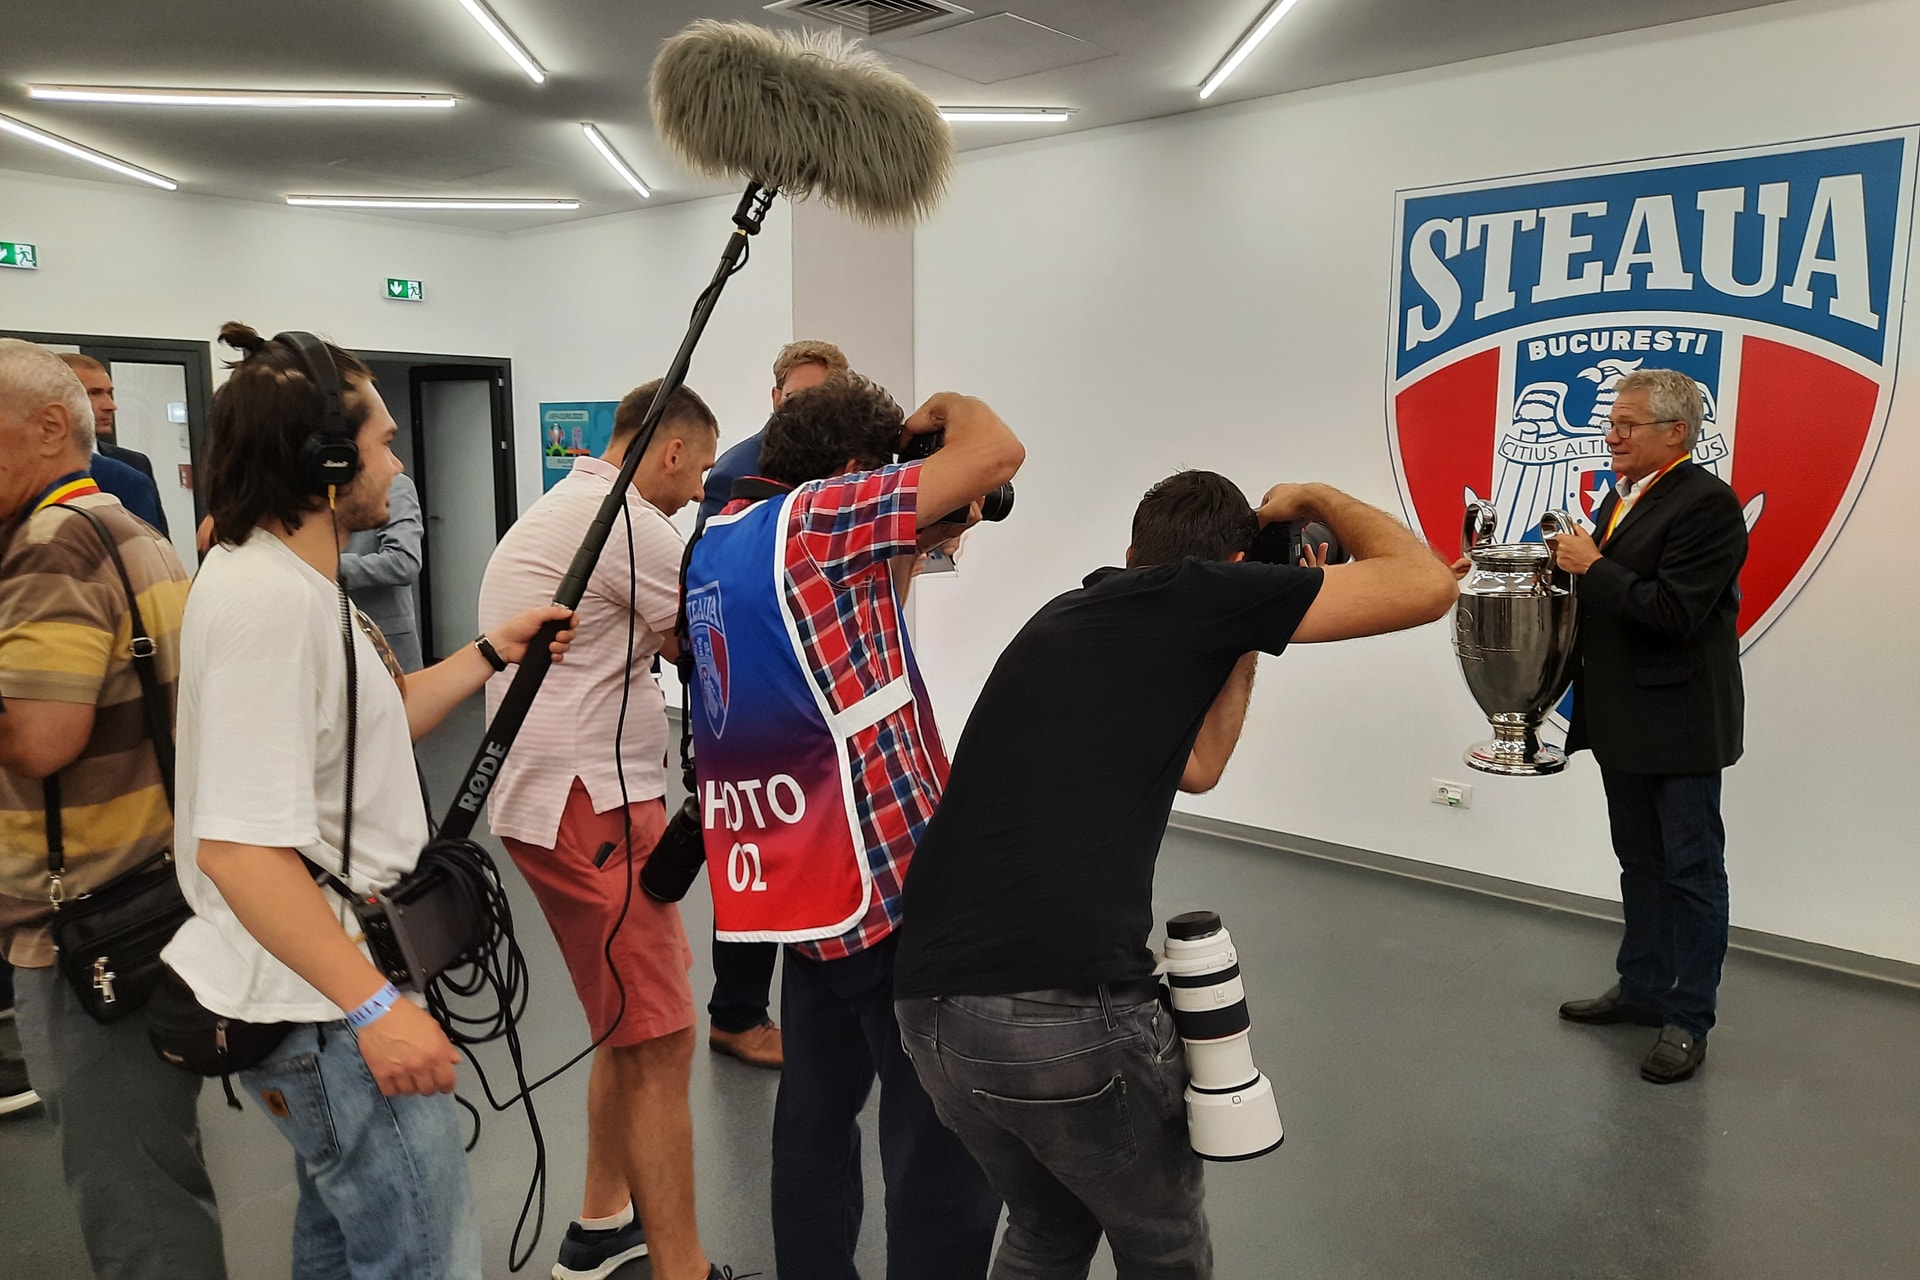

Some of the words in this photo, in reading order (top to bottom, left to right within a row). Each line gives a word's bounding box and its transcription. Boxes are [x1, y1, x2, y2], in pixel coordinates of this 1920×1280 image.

[1405, 173, 1879, 351] STEAUA
[1527, 329, 1708, 362] BUCURESTI
[1502, 441, 1558, 461] CITIUS
[1564, 439, 1612, 456] ALTI
[686, 594, 721, 630] TEAUA
[458, 741, 507, 813] RØDE
[697, 773, 807, 832] HOTO
[727, 842, 768, 893] 02
